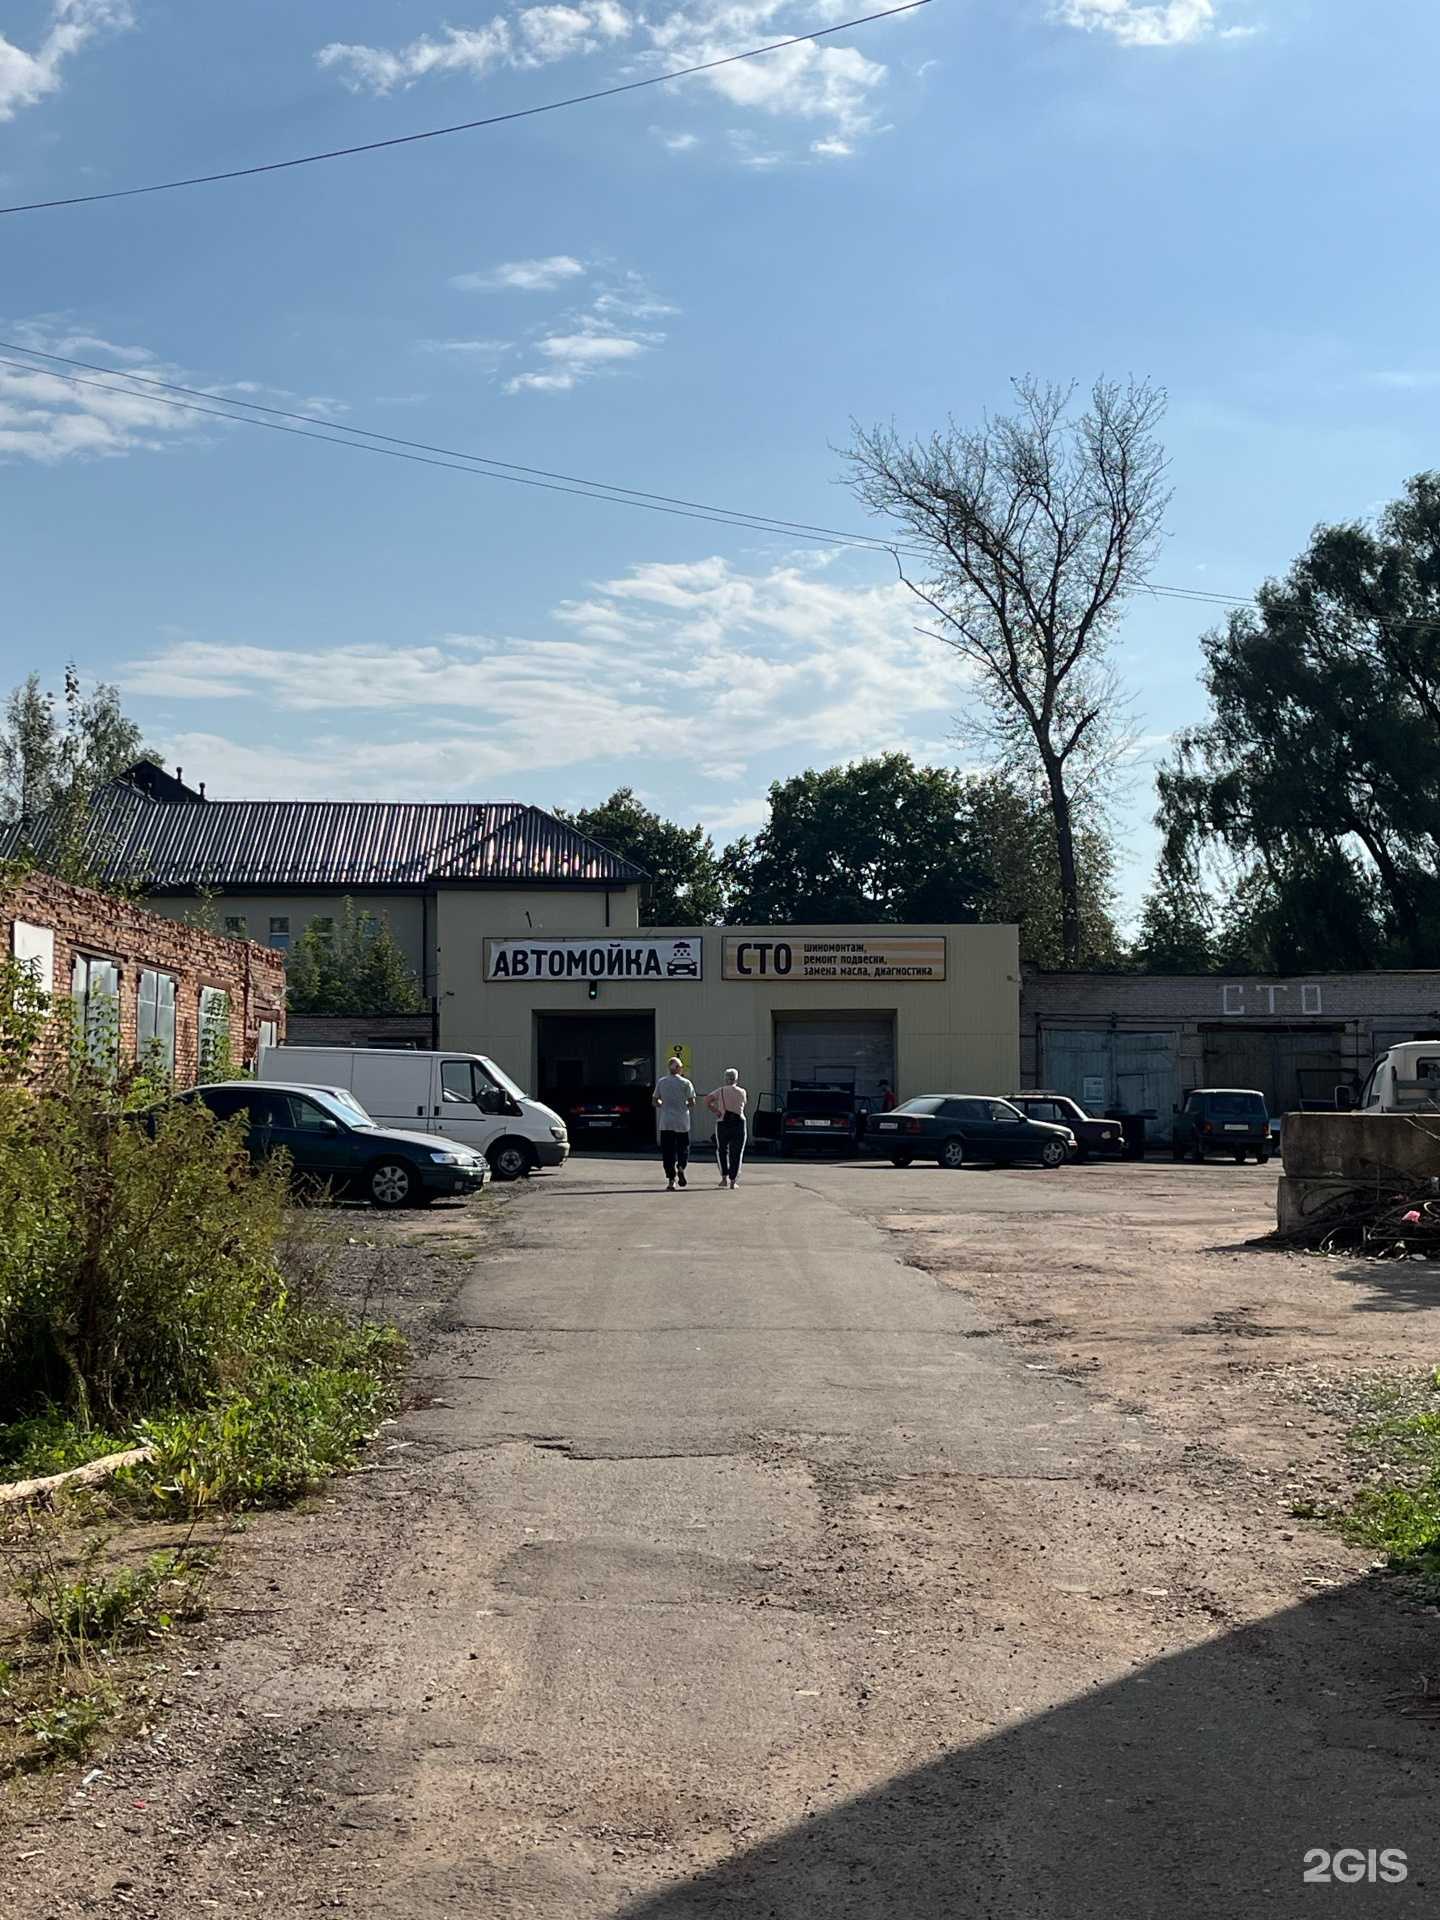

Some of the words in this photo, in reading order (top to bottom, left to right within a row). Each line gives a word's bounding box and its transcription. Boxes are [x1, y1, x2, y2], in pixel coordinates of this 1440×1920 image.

[492, 943, 663, 976] АВТОМОЙКА
[736, 943, 793, 975] СТО
[803, 955, 837, 965] ремонт
[803, 966, 837, 976] замена
[840, 966, 871, 977] масла,
[874, 966, 933, 977] диагностика
[1223, 984, 1322, 1015] СТО
